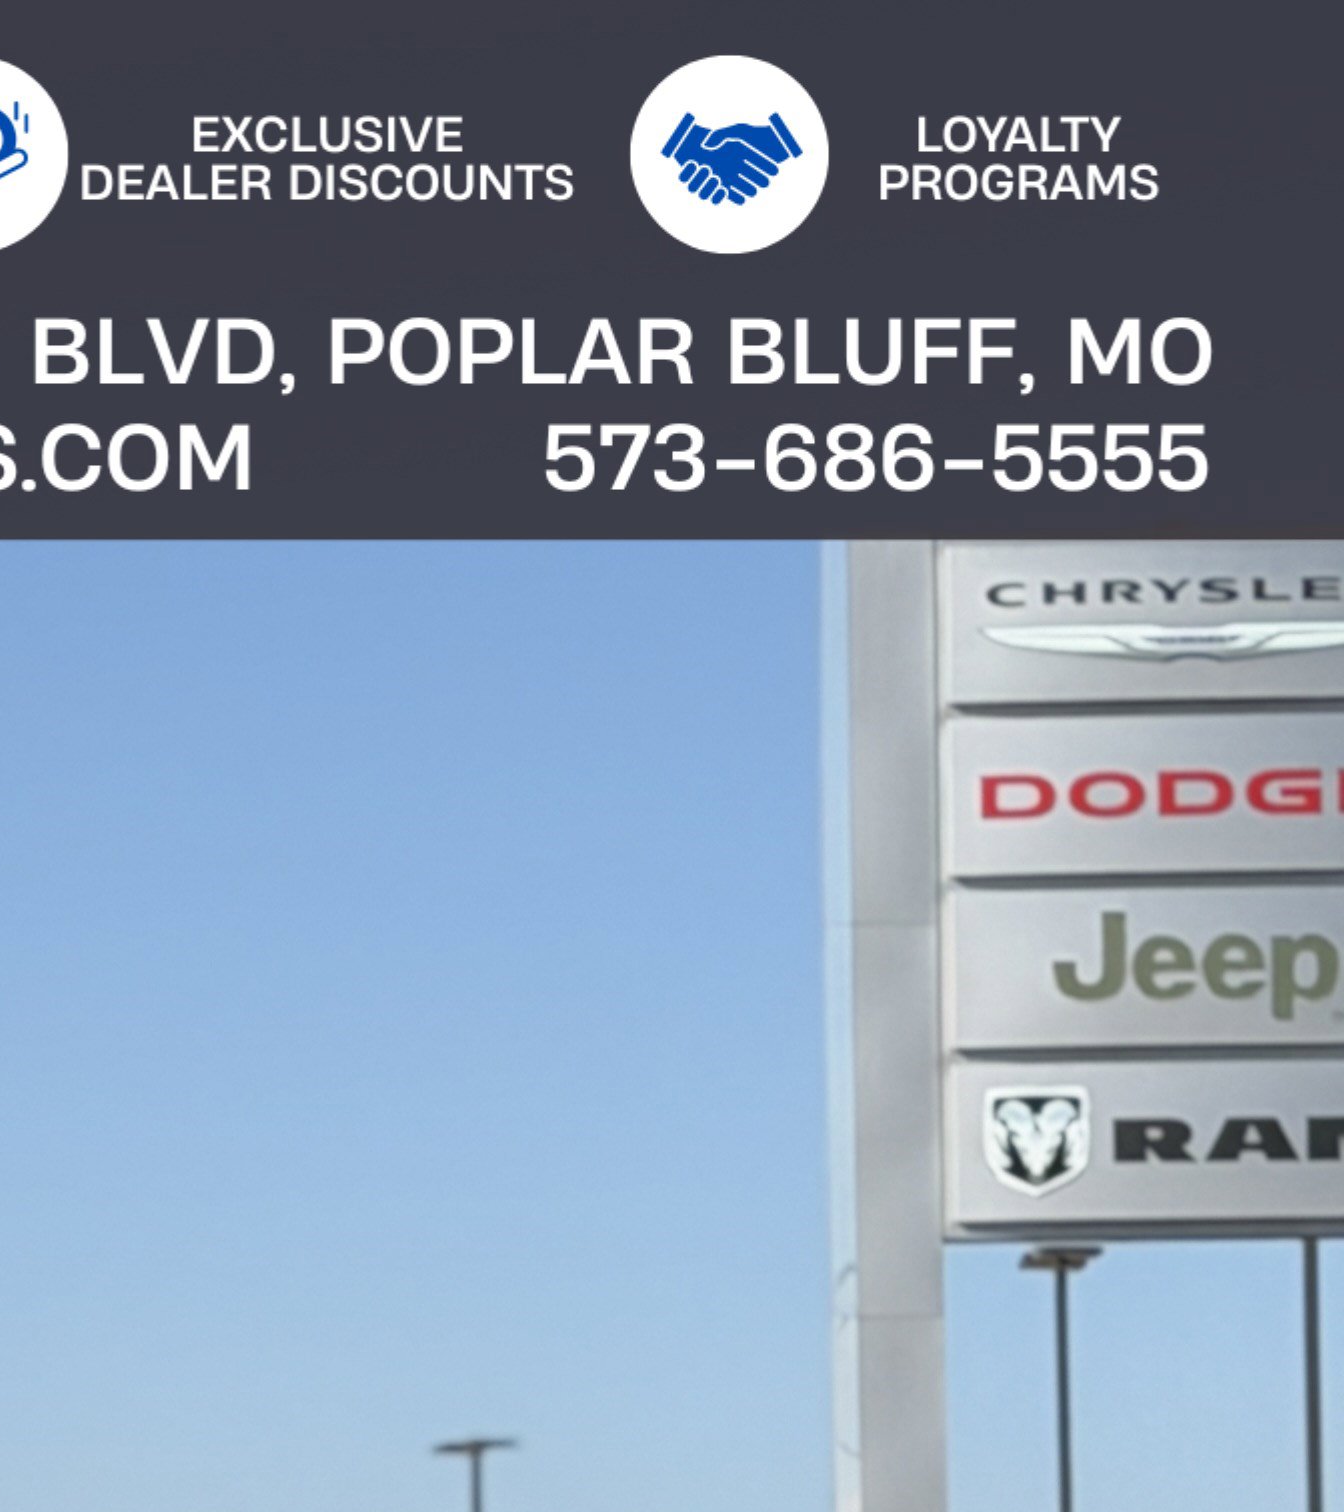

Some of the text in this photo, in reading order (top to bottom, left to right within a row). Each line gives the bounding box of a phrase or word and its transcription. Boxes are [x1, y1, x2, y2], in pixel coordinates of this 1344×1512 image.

[985, 576, 1343, 607] CHRYSLE
[981, 768, 1344, 819] DODG
[1053, 911, 1340, 1021] Jeep
